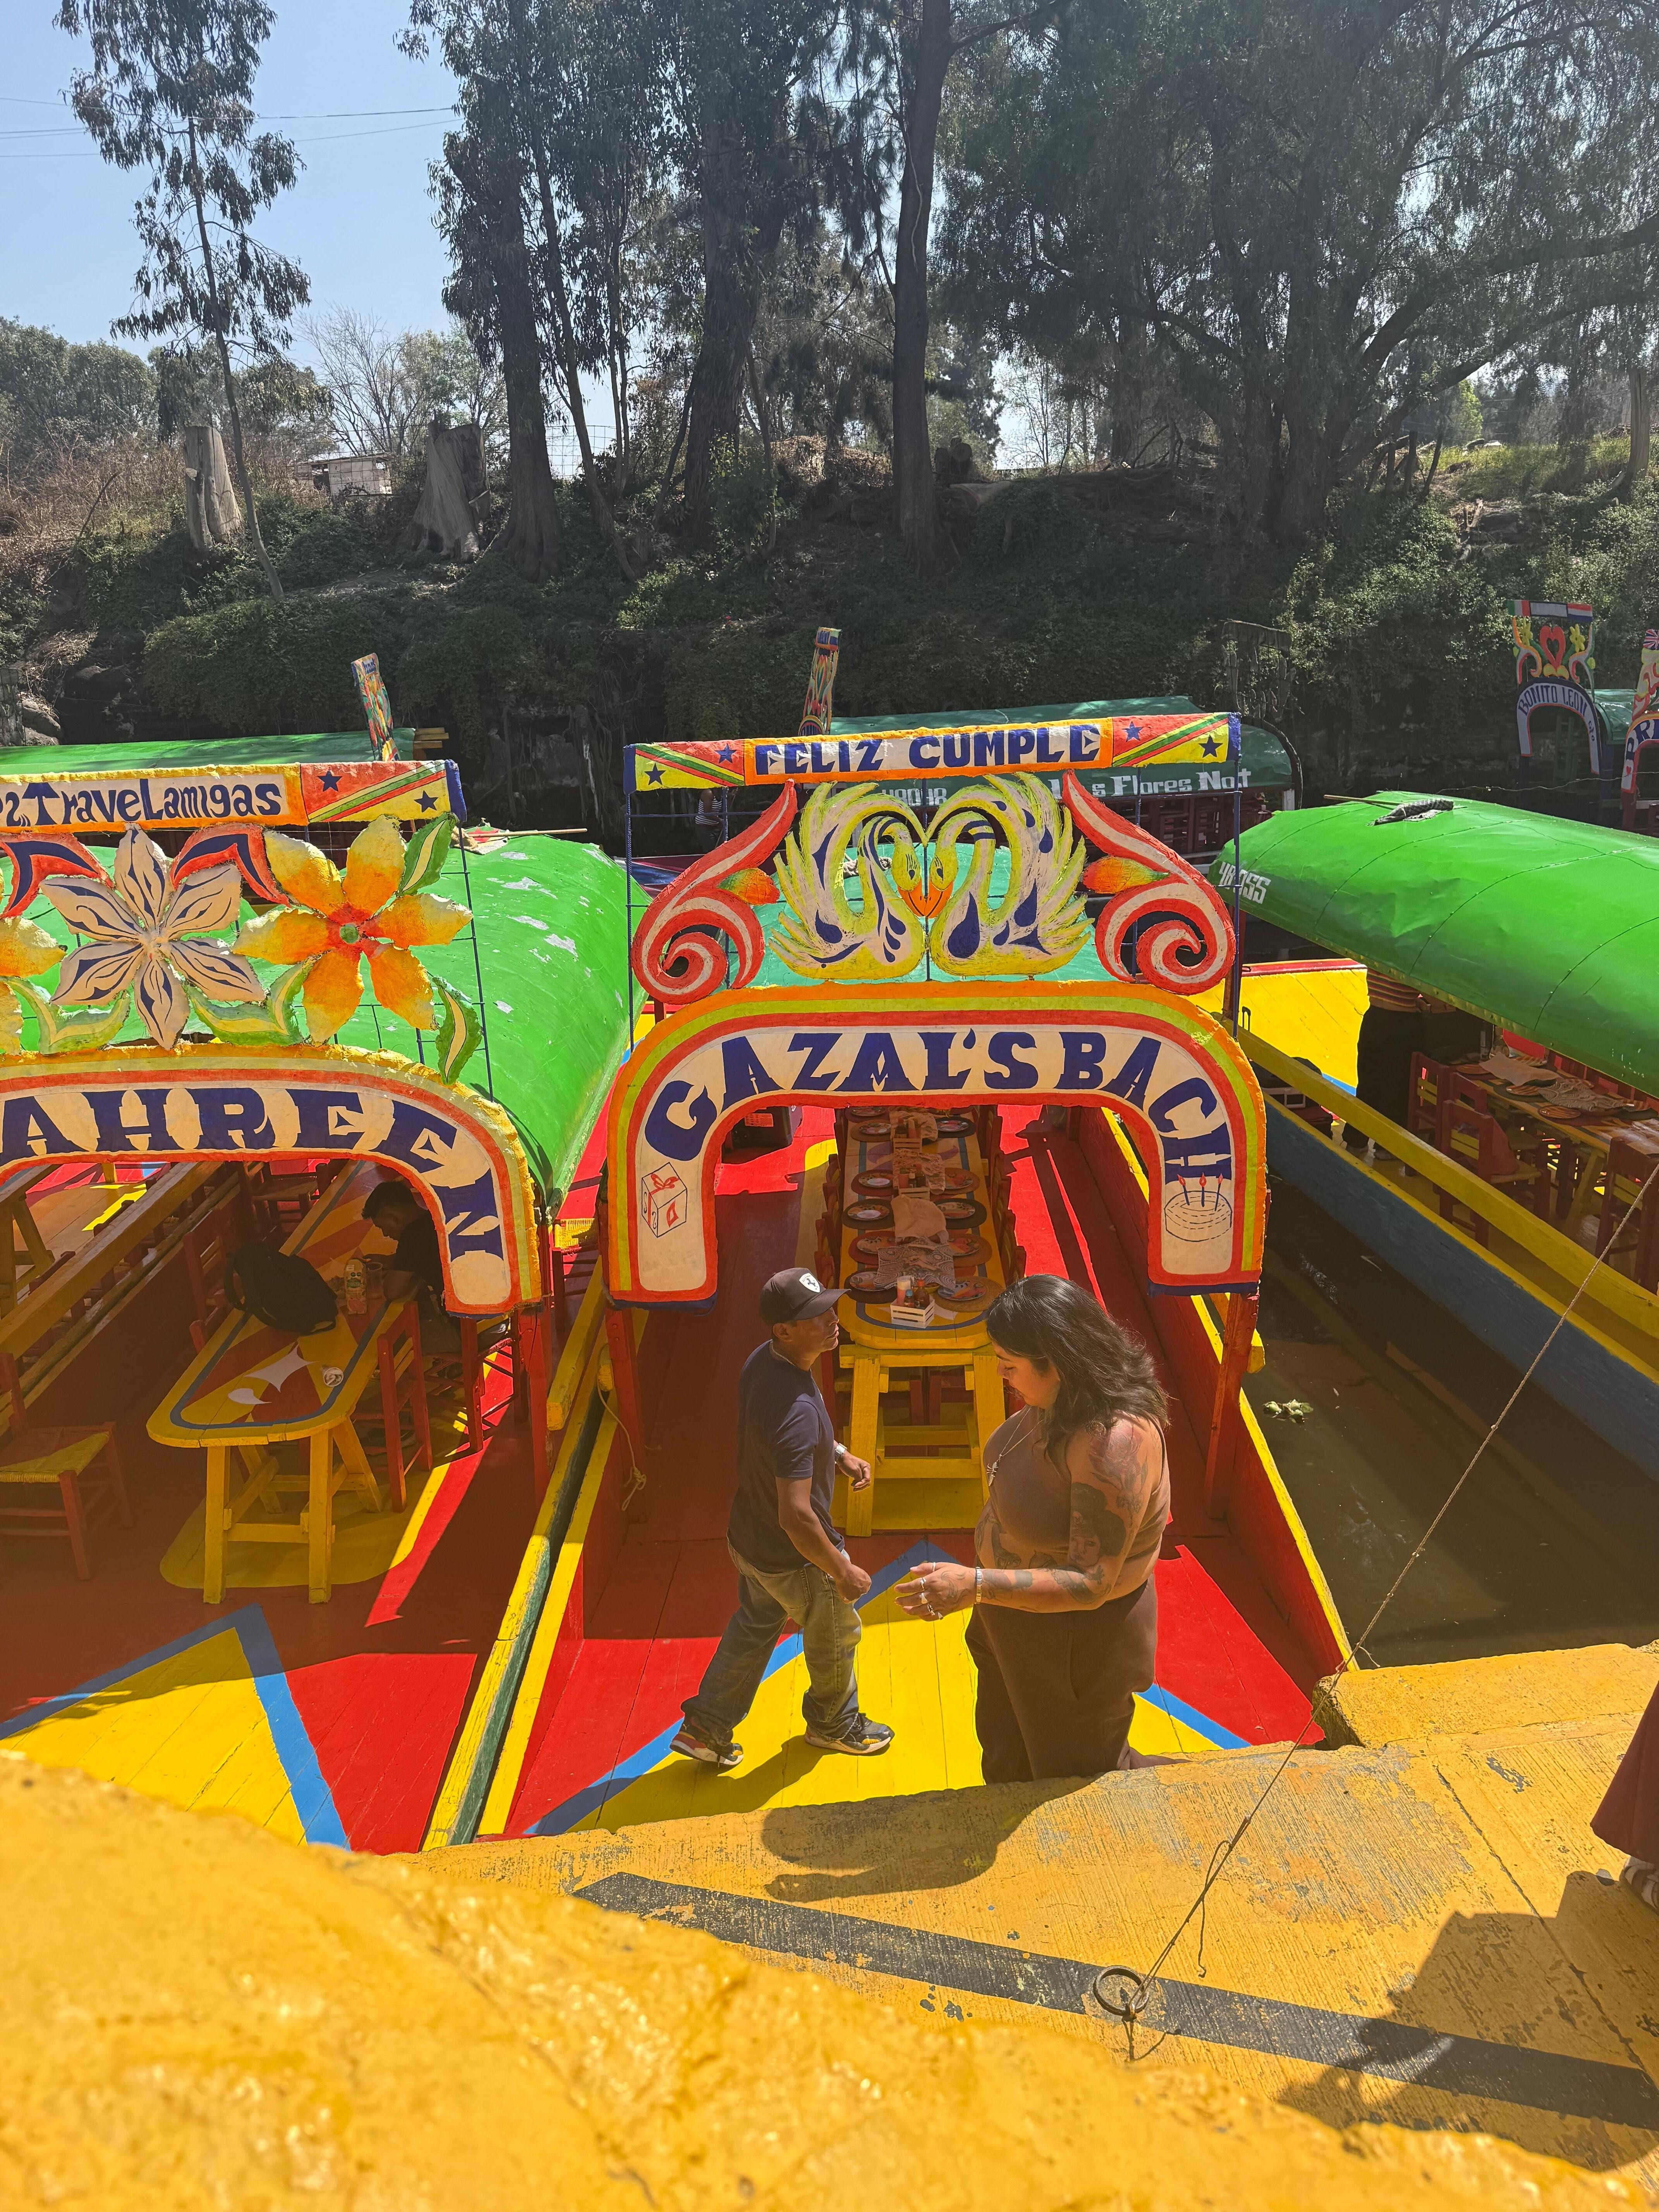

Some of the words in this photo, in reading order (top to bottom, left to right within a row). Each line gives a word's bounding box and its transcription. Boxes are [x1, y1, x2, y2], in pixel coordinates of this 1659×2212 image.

[1518, 685, 1558, 716] BONITO
[1561, 687, 1588, 716] LEON
[755, 739, 883, 775] FELIZ
[908, 724, 1100, 769] CUMPLE
[1110, 775, 1192, 797] Flores
[644, 1028, 1039, 1161] GAZAL'S
[1053, 1031, 1232, 1185] BACH
